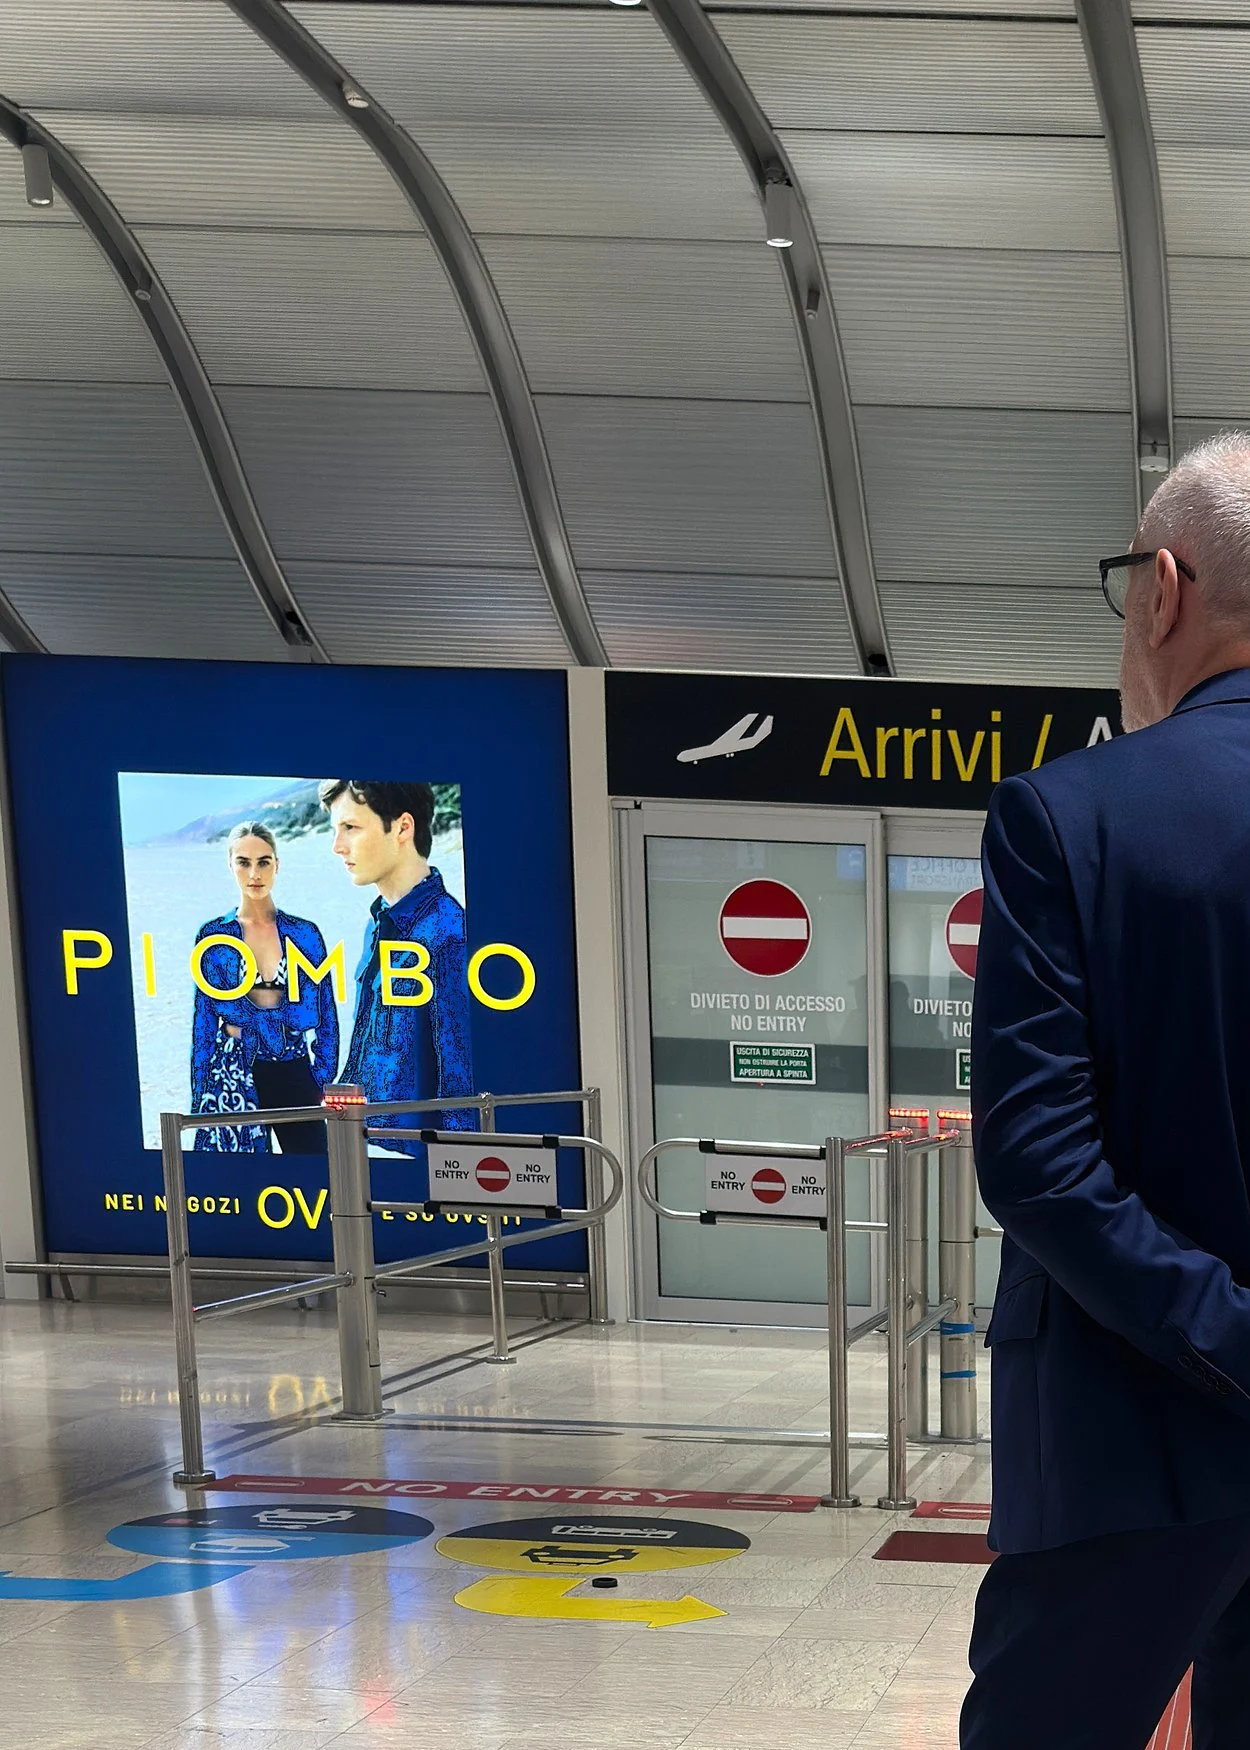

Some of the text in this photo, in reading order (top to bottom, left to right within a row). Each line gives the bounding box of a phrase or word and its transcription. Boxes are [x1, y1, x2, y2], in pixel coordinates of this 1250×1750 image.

[820, 707, 1002, 784] Arrivi
[62, 929, 537, 1011] PIOMBO
[690, 992, 846, 1013] DIVIETO DI ACCESSO
[913, 998, 972, 1017] DIVIETO
[731, 1014, 807, 1033] NO ENTRY
[952, 1021, 972, 1038] NO
[736, 1047, 809, 1058] USCITA DI SICUREZZA
[780, 1059, 788, 1067] LA
[739, 1068, 808, 1078] APERTURA A SPINTA
[444, 1160, 460, 1169] NO
[525, 1163, 541, 1173] NO
[435, 1170, 470, 1180] ENTRY
[516, 1173, 551, 1184] ENTRY
[720, 1171, 736, 1180] NO
[801, 1176, 817, 1185] NO
[711, 1180, 745, 1191] ENTRY
[792, 1185, 826, 1196] ENTRY
[104, 1193, 143, 1211] NEI
[154, 1195, 240, 1214] NGOZI
[257, 1185, 332, 1230] OV
[339, 1481, 694, 1503] NO ENTRY
